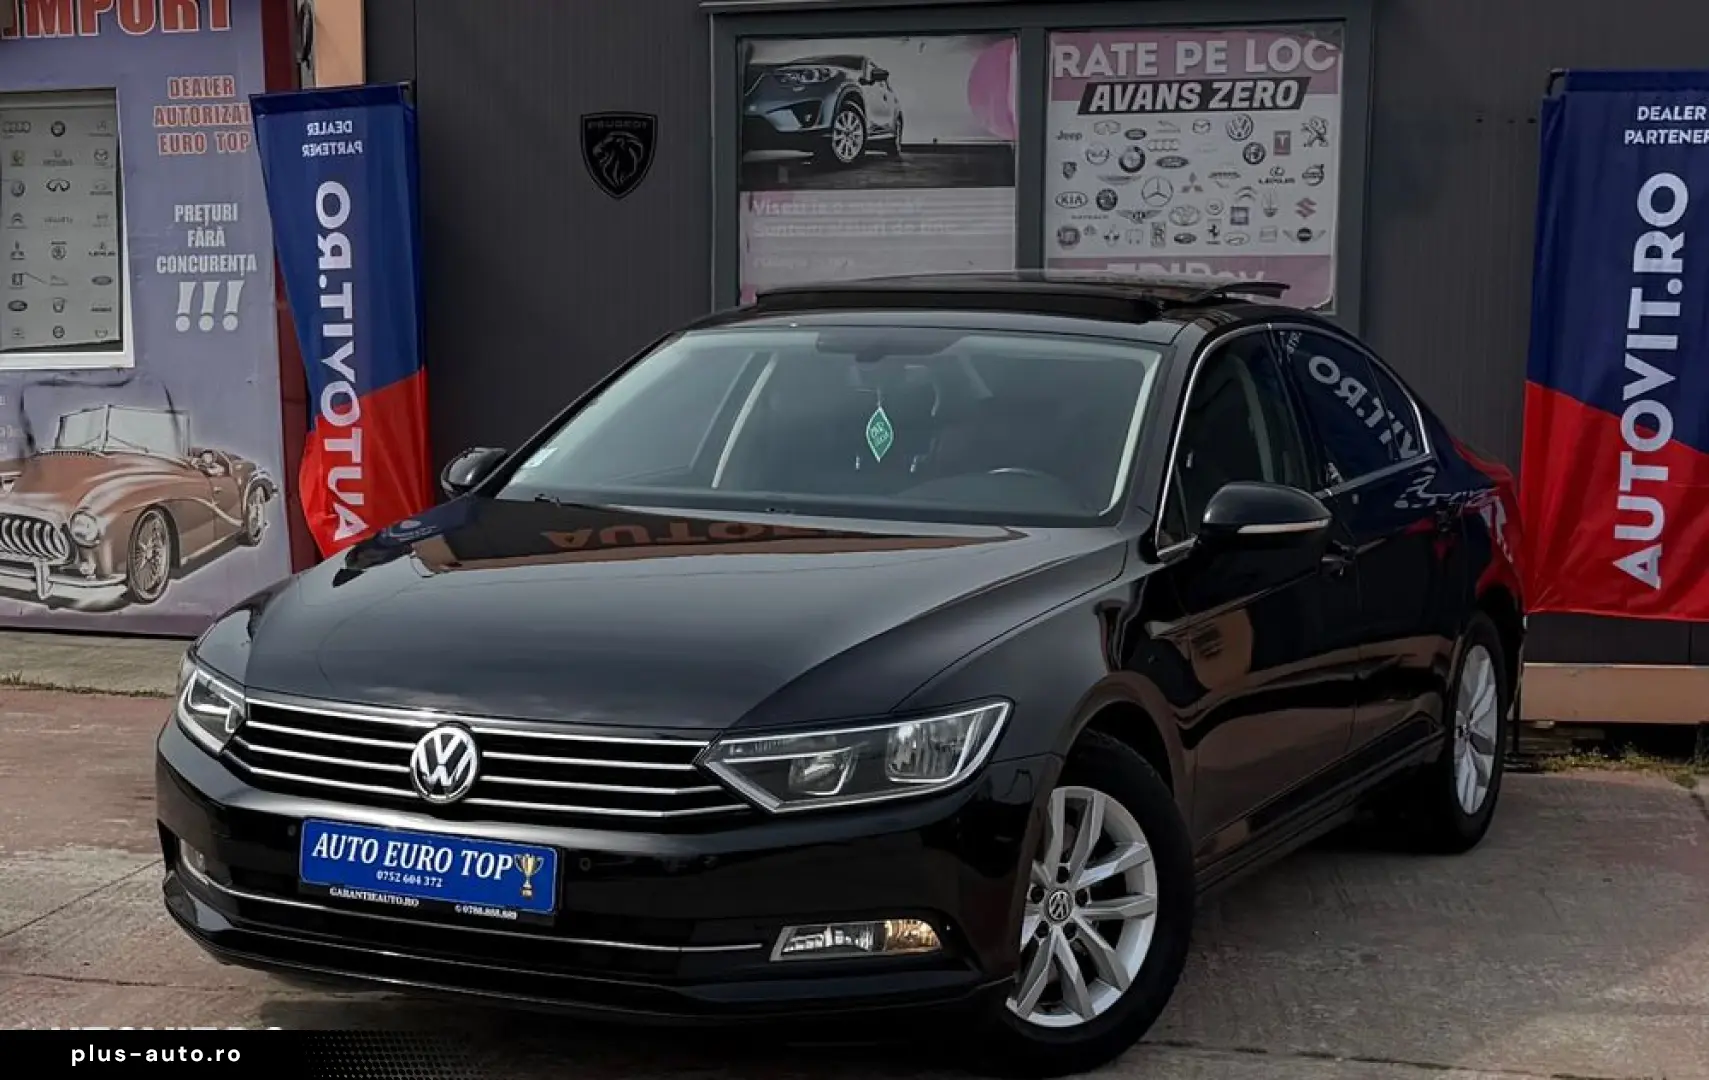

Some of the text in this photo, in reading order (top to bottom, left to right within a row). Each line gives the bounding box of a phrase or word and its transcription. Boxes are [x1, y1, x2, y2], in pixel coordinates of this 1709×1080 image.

[1053, 36, 1338, 78] RATE PE LOC
[167, 75, 236, 99] DEALER
[1089, 79, 1299, 112] AVANS ZERO
[153, 102, 252, 128] AUTORIZAT
[1636, 105, 1708, 122] DEALER
[158, 131, 252, 156] EURO TOP
[1059, 194, 1085, 206] KIA
[175, 280, 245, 332] !!!
[1612, 172, 1689, 590] AUTOVIT.RO
[311, 832, 513, 881] AUTO EURO TOP
[376, 870, 401, 883] 0752
[423, 875, 444, 888] 372
